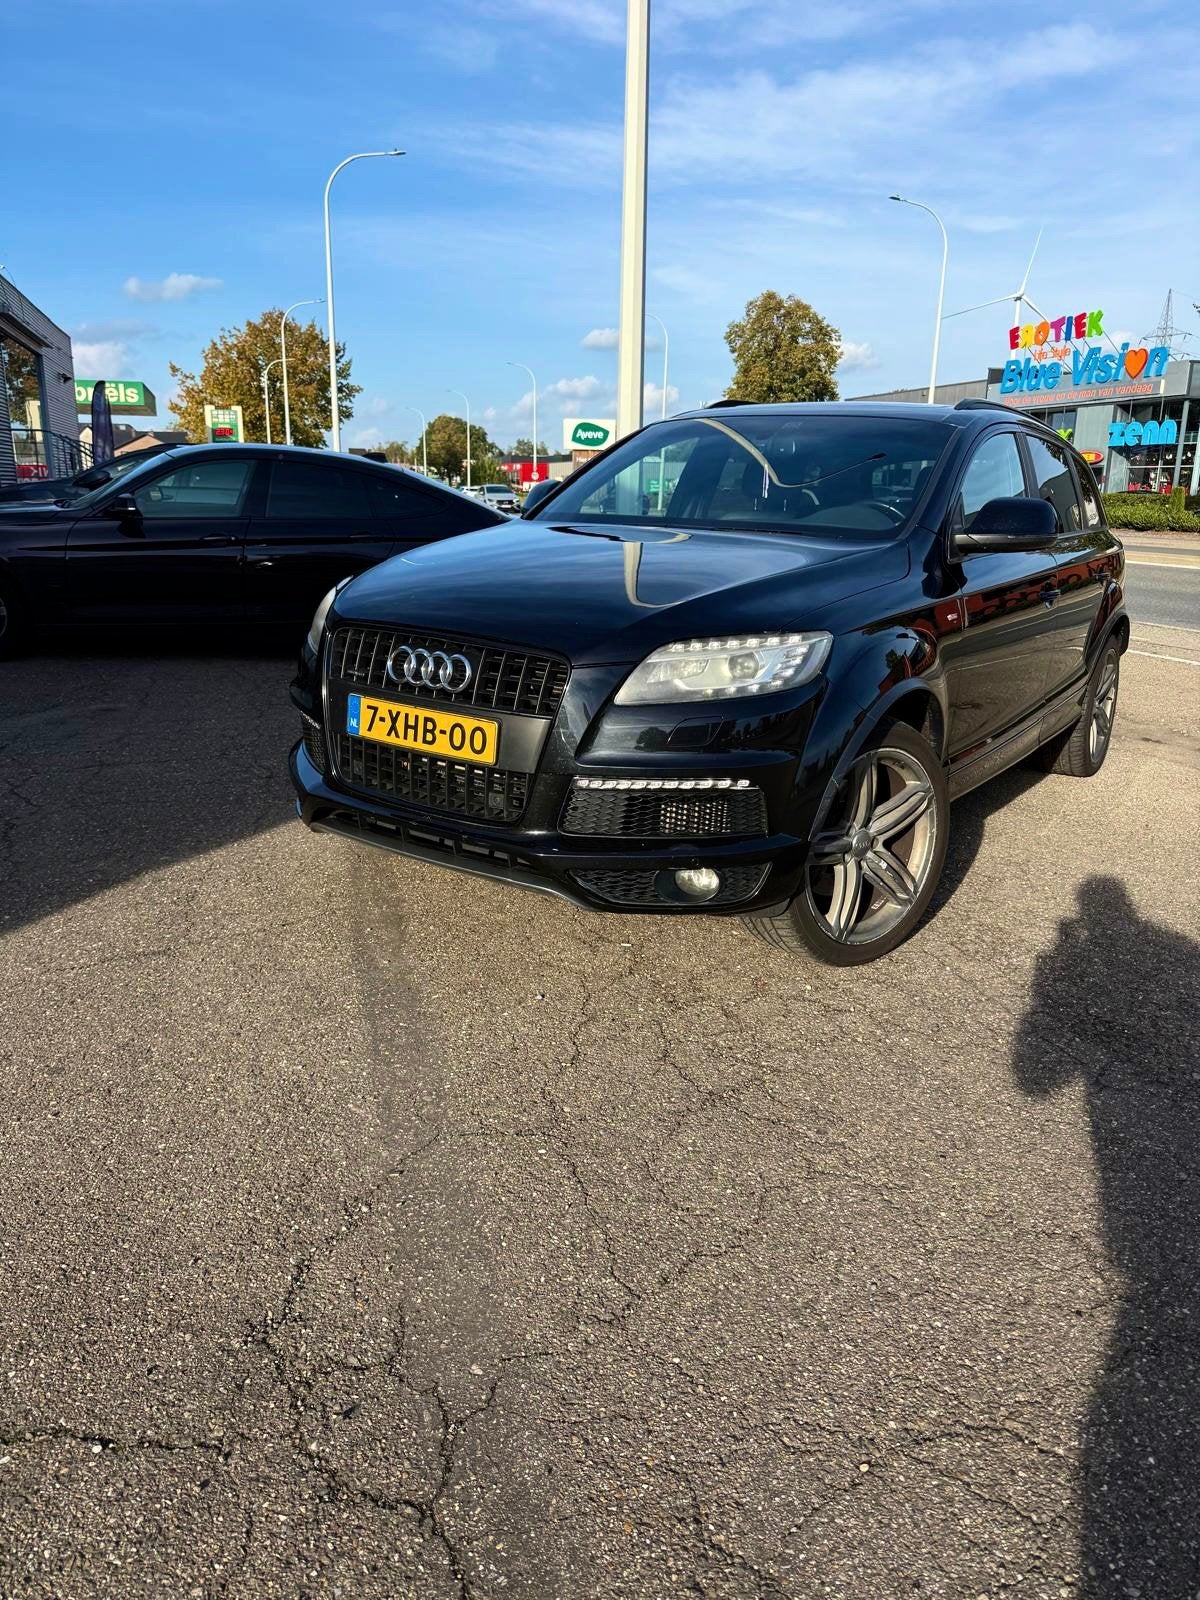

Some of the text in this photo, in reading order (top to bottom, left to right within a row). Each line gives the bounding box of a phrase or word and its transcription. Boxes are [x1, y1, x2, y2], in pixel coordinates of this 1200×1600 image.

[1000, 357, 1062, 394] Blue
[1098, 387, 1113, 397] van
[1115, 383, 1153, 395] vandaag
[576, 429, 604, 440] Aveve
[1107, 419, 1177, 447] zenn
[349, 717, 358, 728] NL
[366, 705, 487, 755] 7-XHB-00
